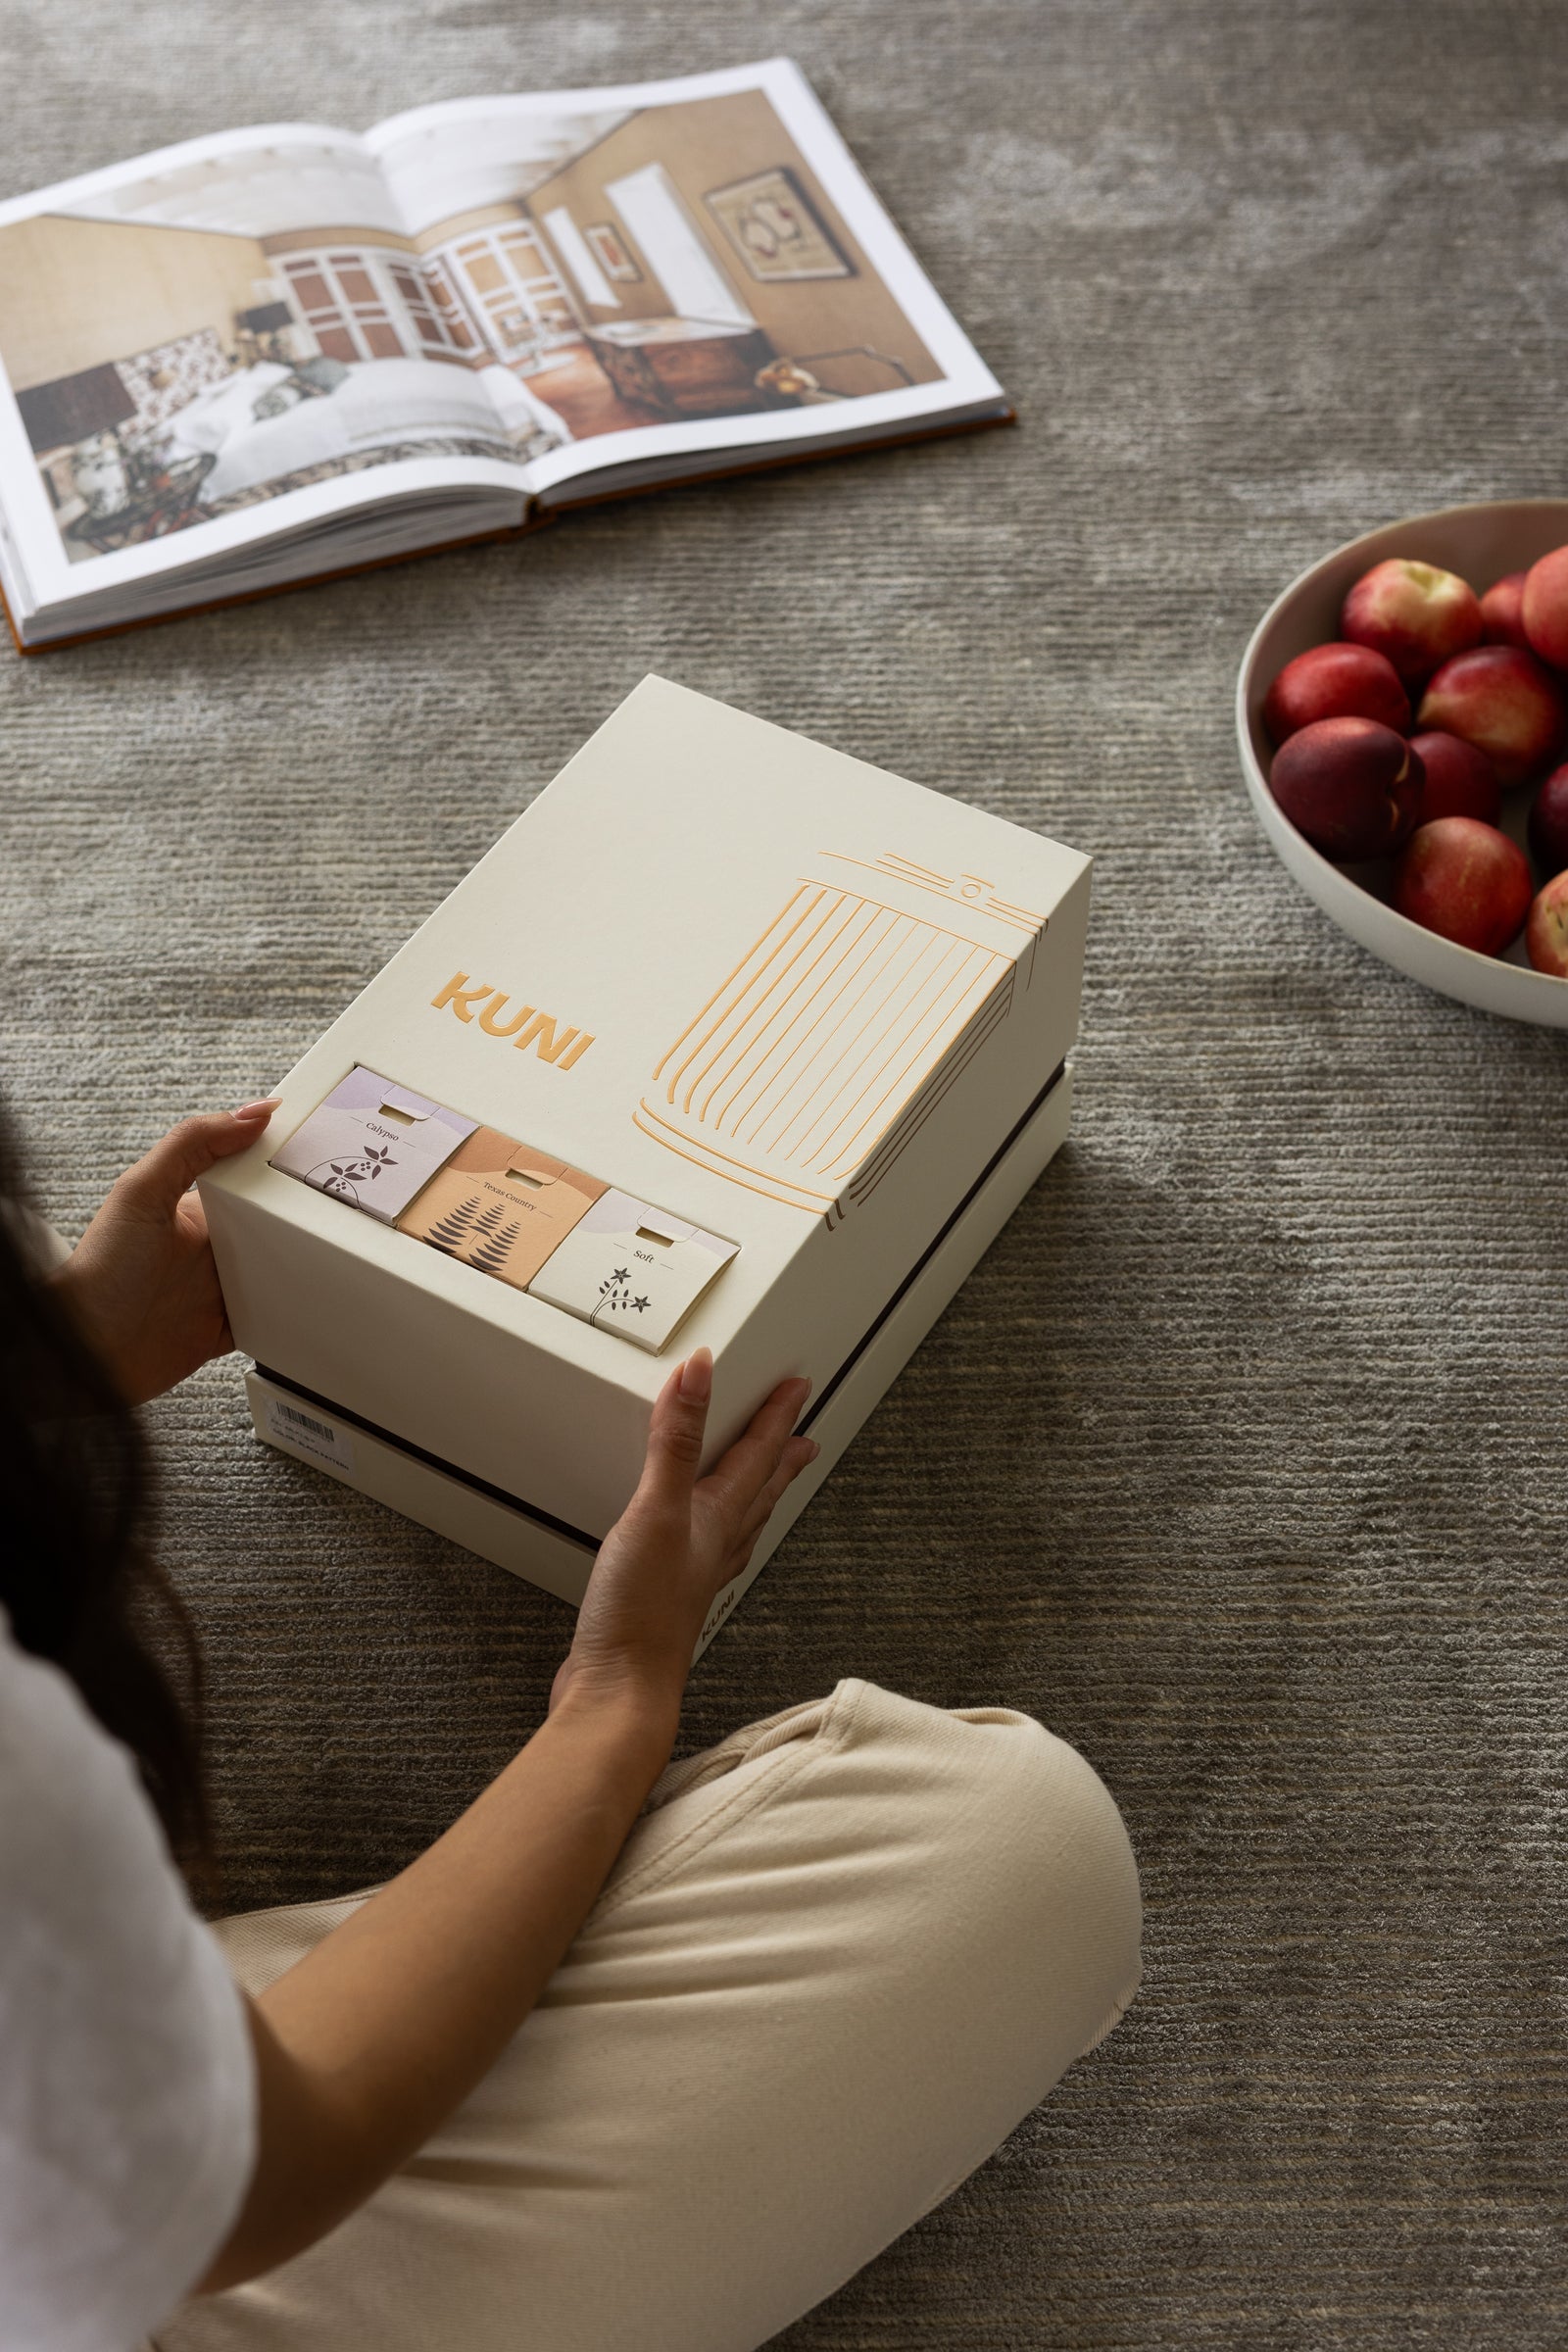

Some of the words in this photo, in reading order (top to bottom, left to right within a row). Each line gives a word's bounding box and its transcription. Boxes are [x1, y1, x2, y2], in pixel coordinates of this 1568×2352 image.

[430, 971, 596, 1071] KUNI
[366, 1122, 399, 1142] Calypso
[483, 1181, 506, 1196] Texas
[505, 1193, 537, 1211] Country
[633, 1250, 655, 1263] Soft
[702, 1589, 734, 1642] KUNI
